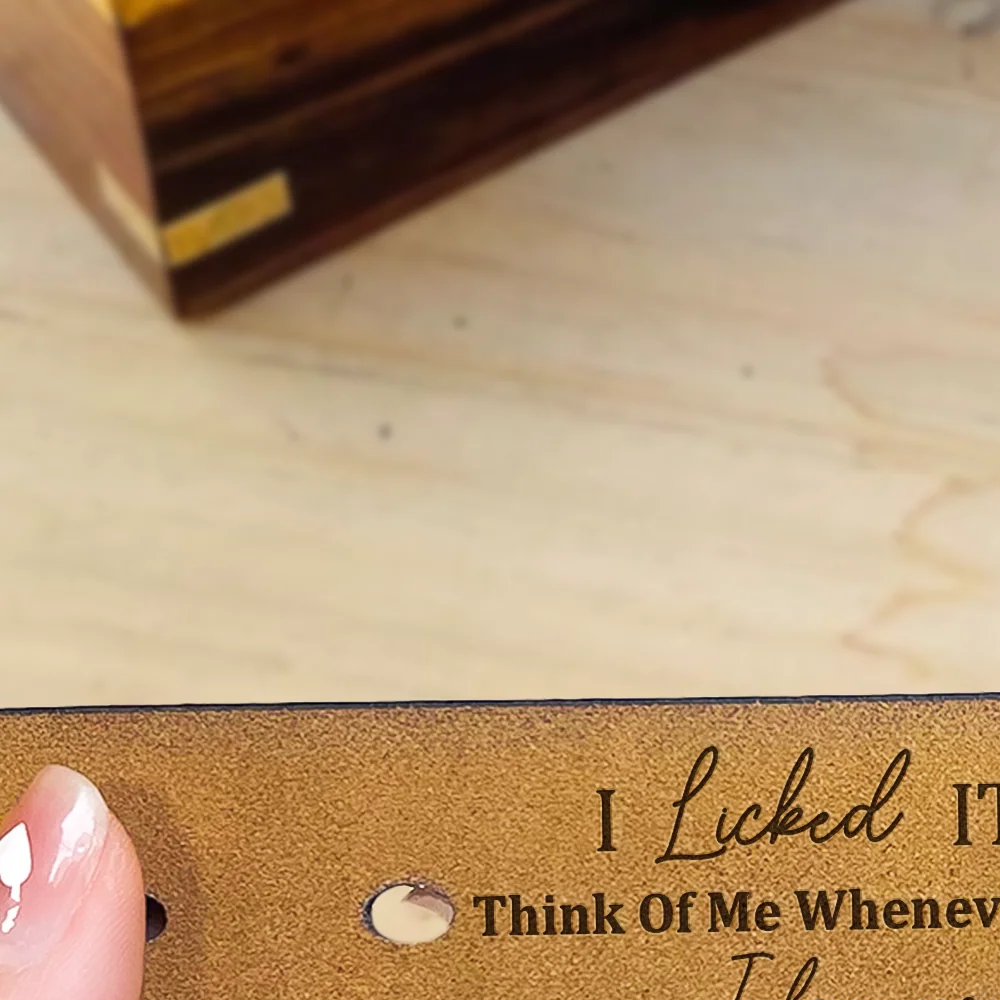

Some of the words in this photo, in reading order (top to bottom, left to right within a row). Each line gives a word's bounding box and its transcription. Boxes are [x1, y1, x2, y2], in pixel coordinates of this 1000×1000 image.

[596, 788, 617, 852] I
[655, 745, 912, 864] Licked
[473, 892, 624, 936] Think
[638, 891, 697, 933] Of
[707, 892, 781, 932] Me
